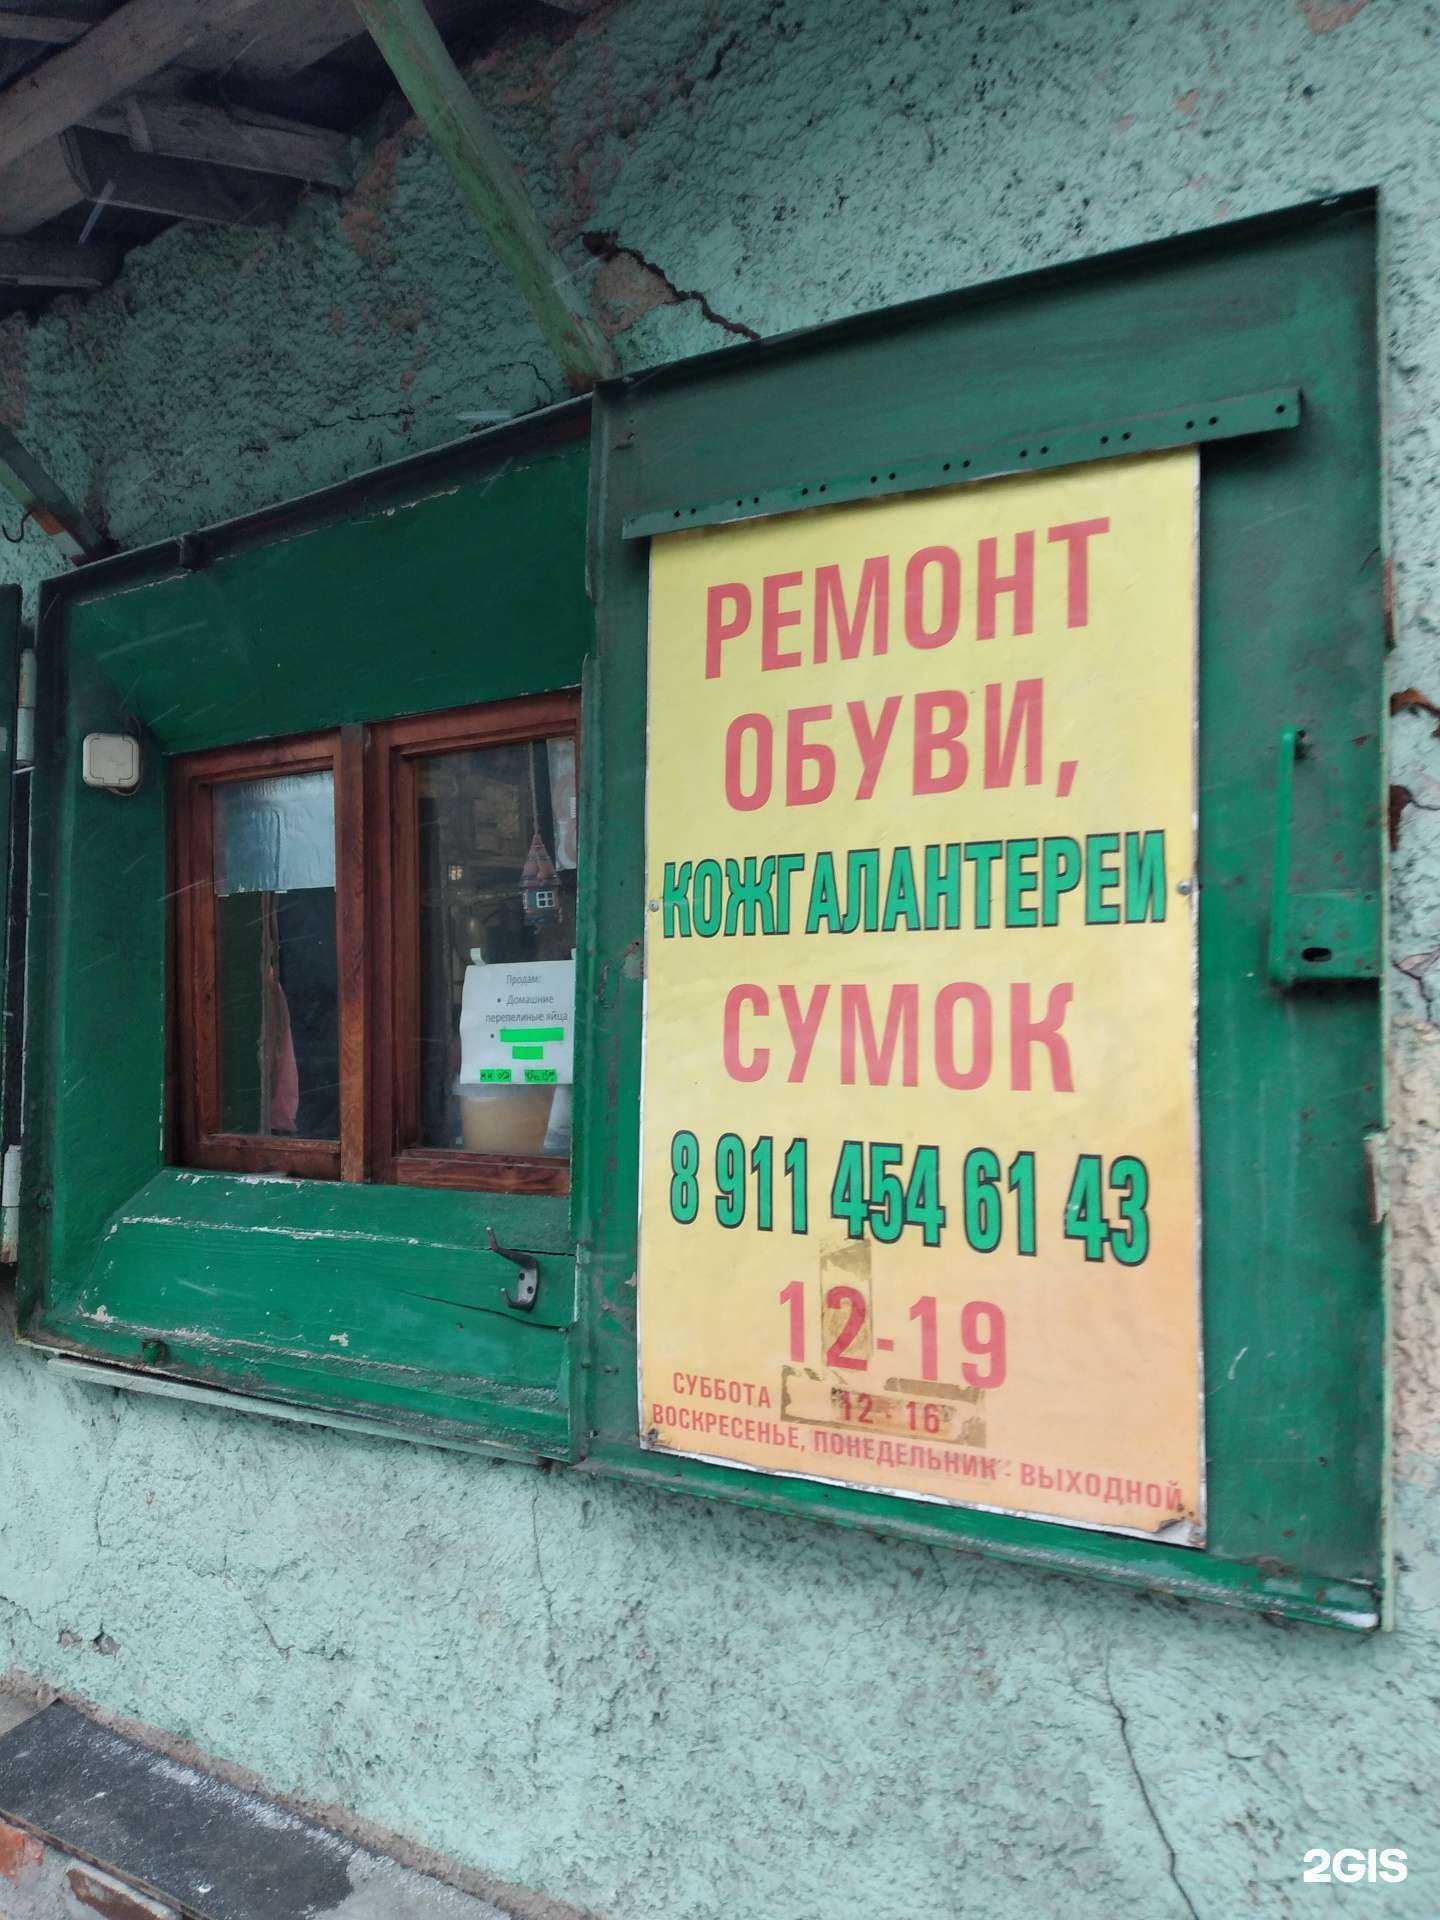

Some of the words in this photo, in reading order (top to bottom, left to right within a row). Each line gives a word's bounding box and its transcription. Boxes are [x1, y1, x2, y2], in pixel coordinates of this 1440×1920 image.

[705, 517, 1110, 679] РЕМОНТ
[724, 678, 1079, 812] ОБУВИ,
[662, 829, 1167, 938] КОЖГАЛАНТЕРЕИ
[505, 995, 554, 1006] Домашние
[723, 982, 1075, 1093] СУМОК
[670, 1130, 700, 1225] 8
[715, 1133, 808, 1235] 911
[831, 1140, 946, 1247] 454
[963, 1147, 1037, 1257] 61
[1064, 1154, 1150, 1267] 43
[779, 1280, 1006, 1389] 12-19
[673, 1372, 772, 1409] СУББОТА
[652, 1404, 805, 1452] ВОСКРЕСЕНЬЕ,
[1020, 1461, 1183, 1511] ВЫХОДНОЙ
